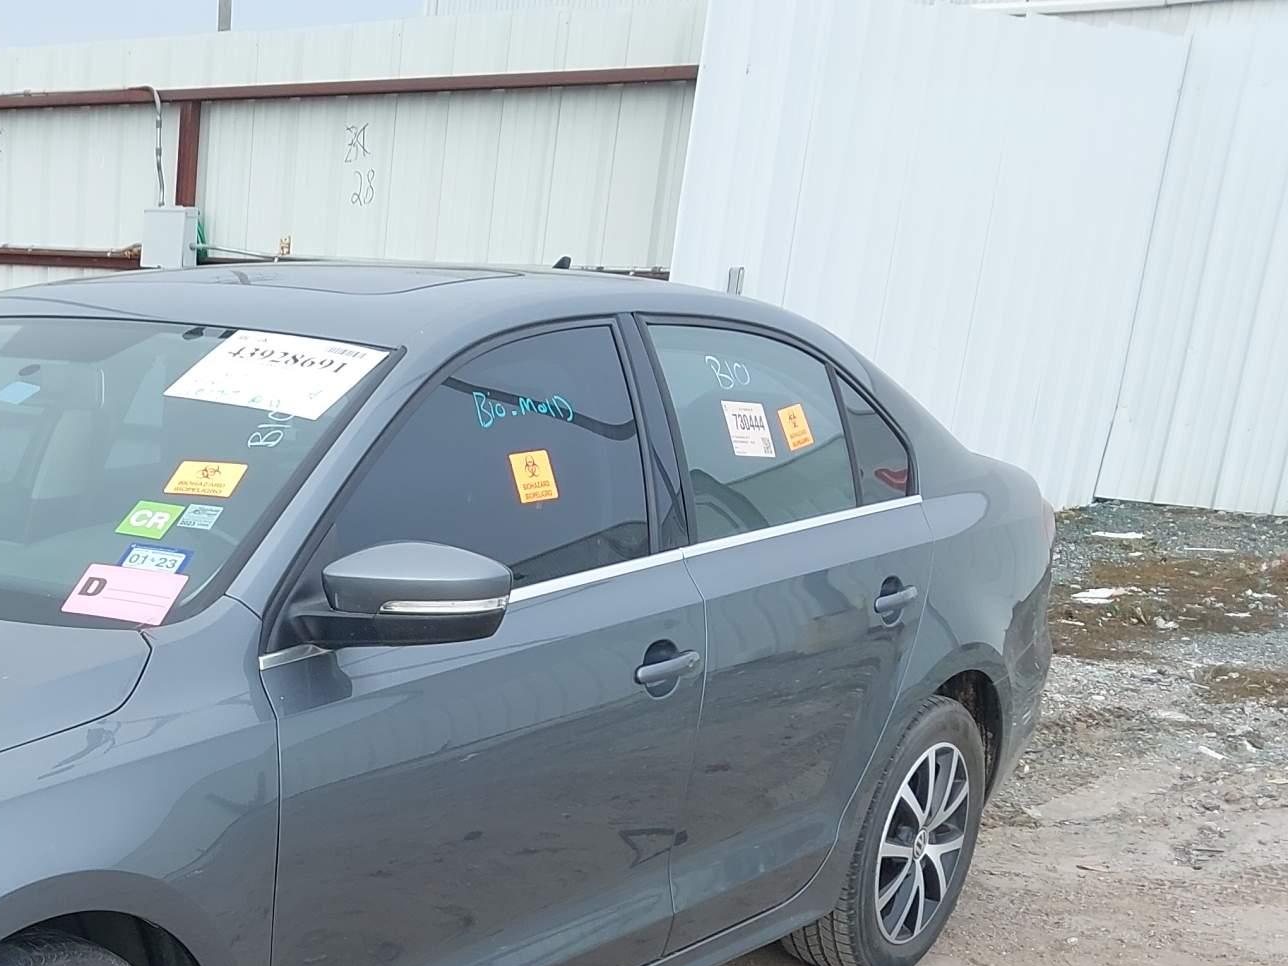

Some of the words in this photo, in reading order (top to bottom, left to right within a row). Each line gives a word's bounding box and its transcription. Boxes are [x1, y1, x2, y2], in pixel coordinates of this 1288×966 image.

[227, 345, 348, 374] 43928691
[705, 355, 751, 390] BIO
[731, 413, 766, 431] 730444
[129, 509, 171, 530] CR
[128, 553, 149, 565] 01
[154, 557, 178, 569] 23
[78, 576, 107, 596] D
